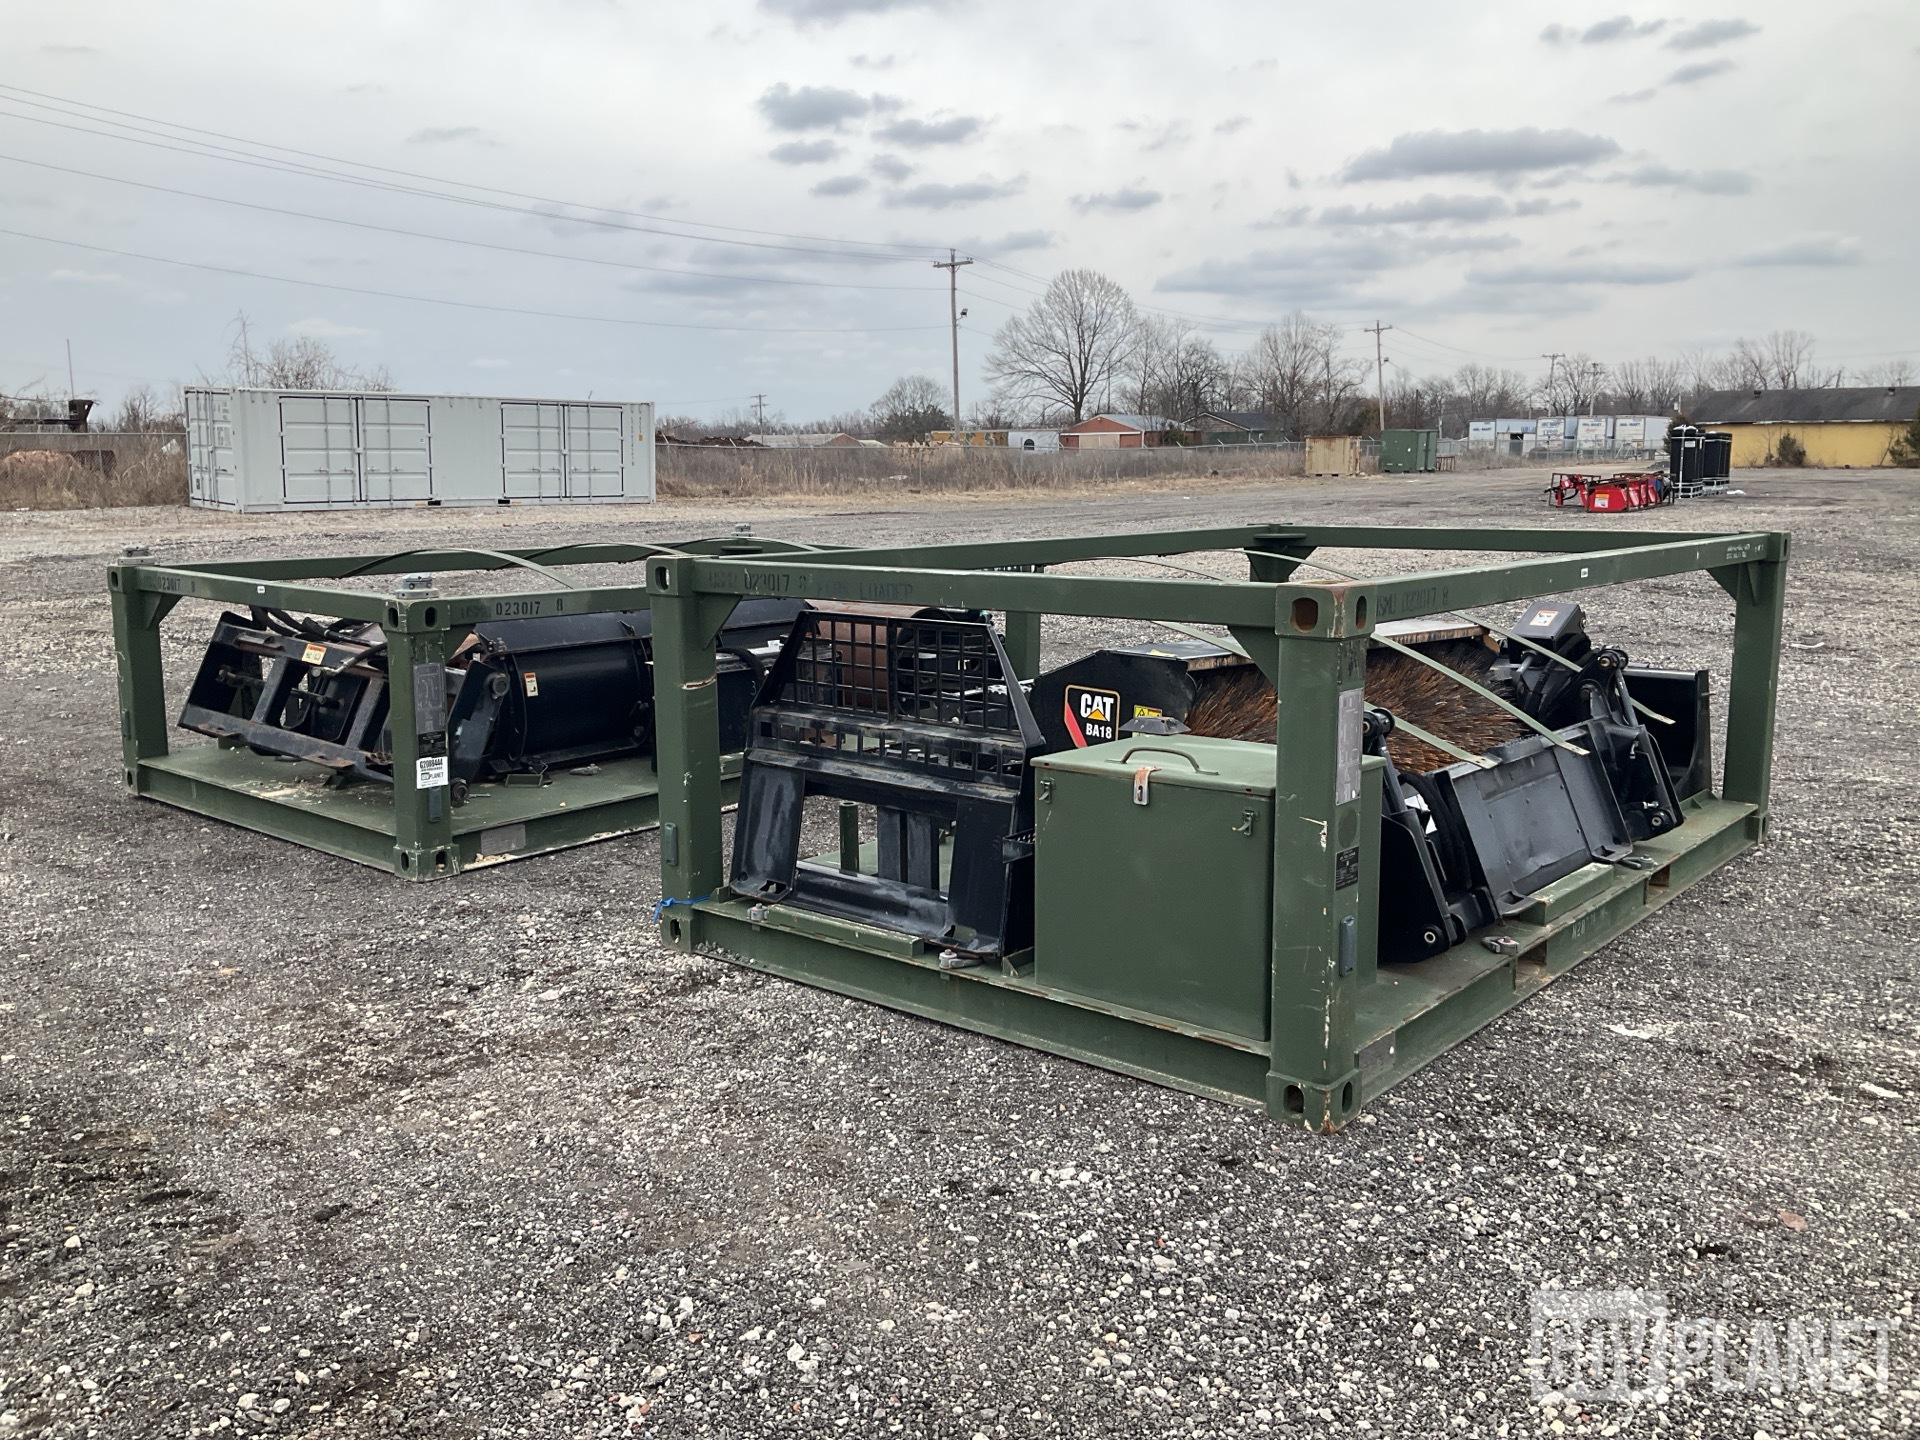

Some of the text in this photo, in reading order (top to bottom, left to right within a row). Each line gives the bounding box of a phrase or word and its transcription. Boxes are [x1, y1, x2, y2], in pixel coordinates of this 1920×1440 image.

[496, 601, 541, 616] 023017
[1080, 693, 1114, 722] CAT
[1086, 722, 1112, 739] BA18
